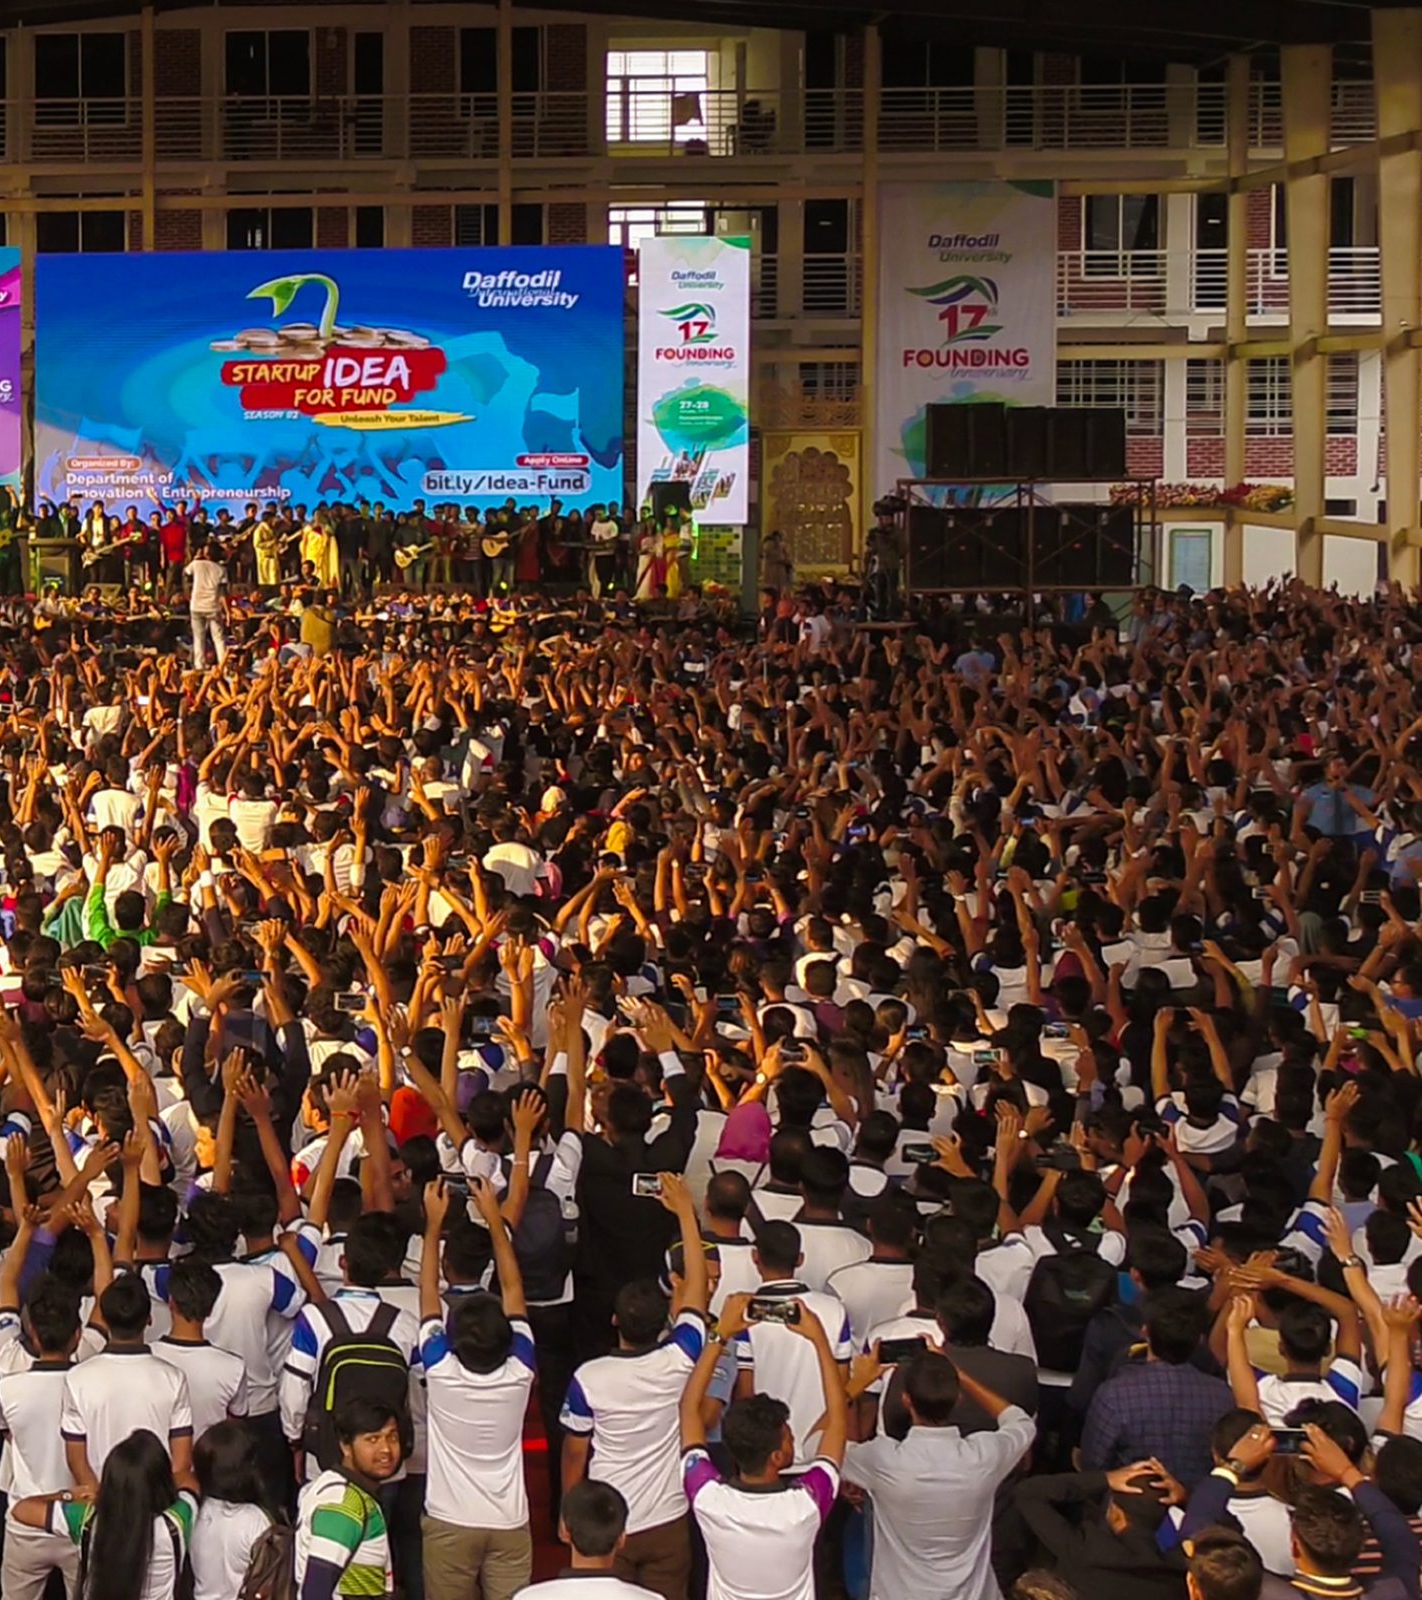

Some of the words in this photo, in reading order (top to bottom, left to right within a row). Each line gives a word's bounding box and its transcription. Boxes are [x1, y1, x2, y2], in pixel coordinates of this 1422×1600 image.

[928, 233, 1000, 248] Daffodil
[939, 252, 1013, 264] University
[462, 270, 562, 289] Daffodil
[671, 271, 717, 280] Daffodil
[478, 291, 580, 309] University
[655, 347, 735, 360] FOUNDING
[903, 348, 1030, 368] FOUNDING
[231, 363, 321, 383] STARTUP
[323, 355, 412, 390] IDEA
[293, 388, 336, 407] FOR
[341, 388, 397, 406] FUND
[66, 472, 155, 486] Department
[158, 471, 174, 485] of
[425, 474, 586, 494] bit.ly/Idea-Fund
[161, 486, 292, 500] Entrpreneurship
